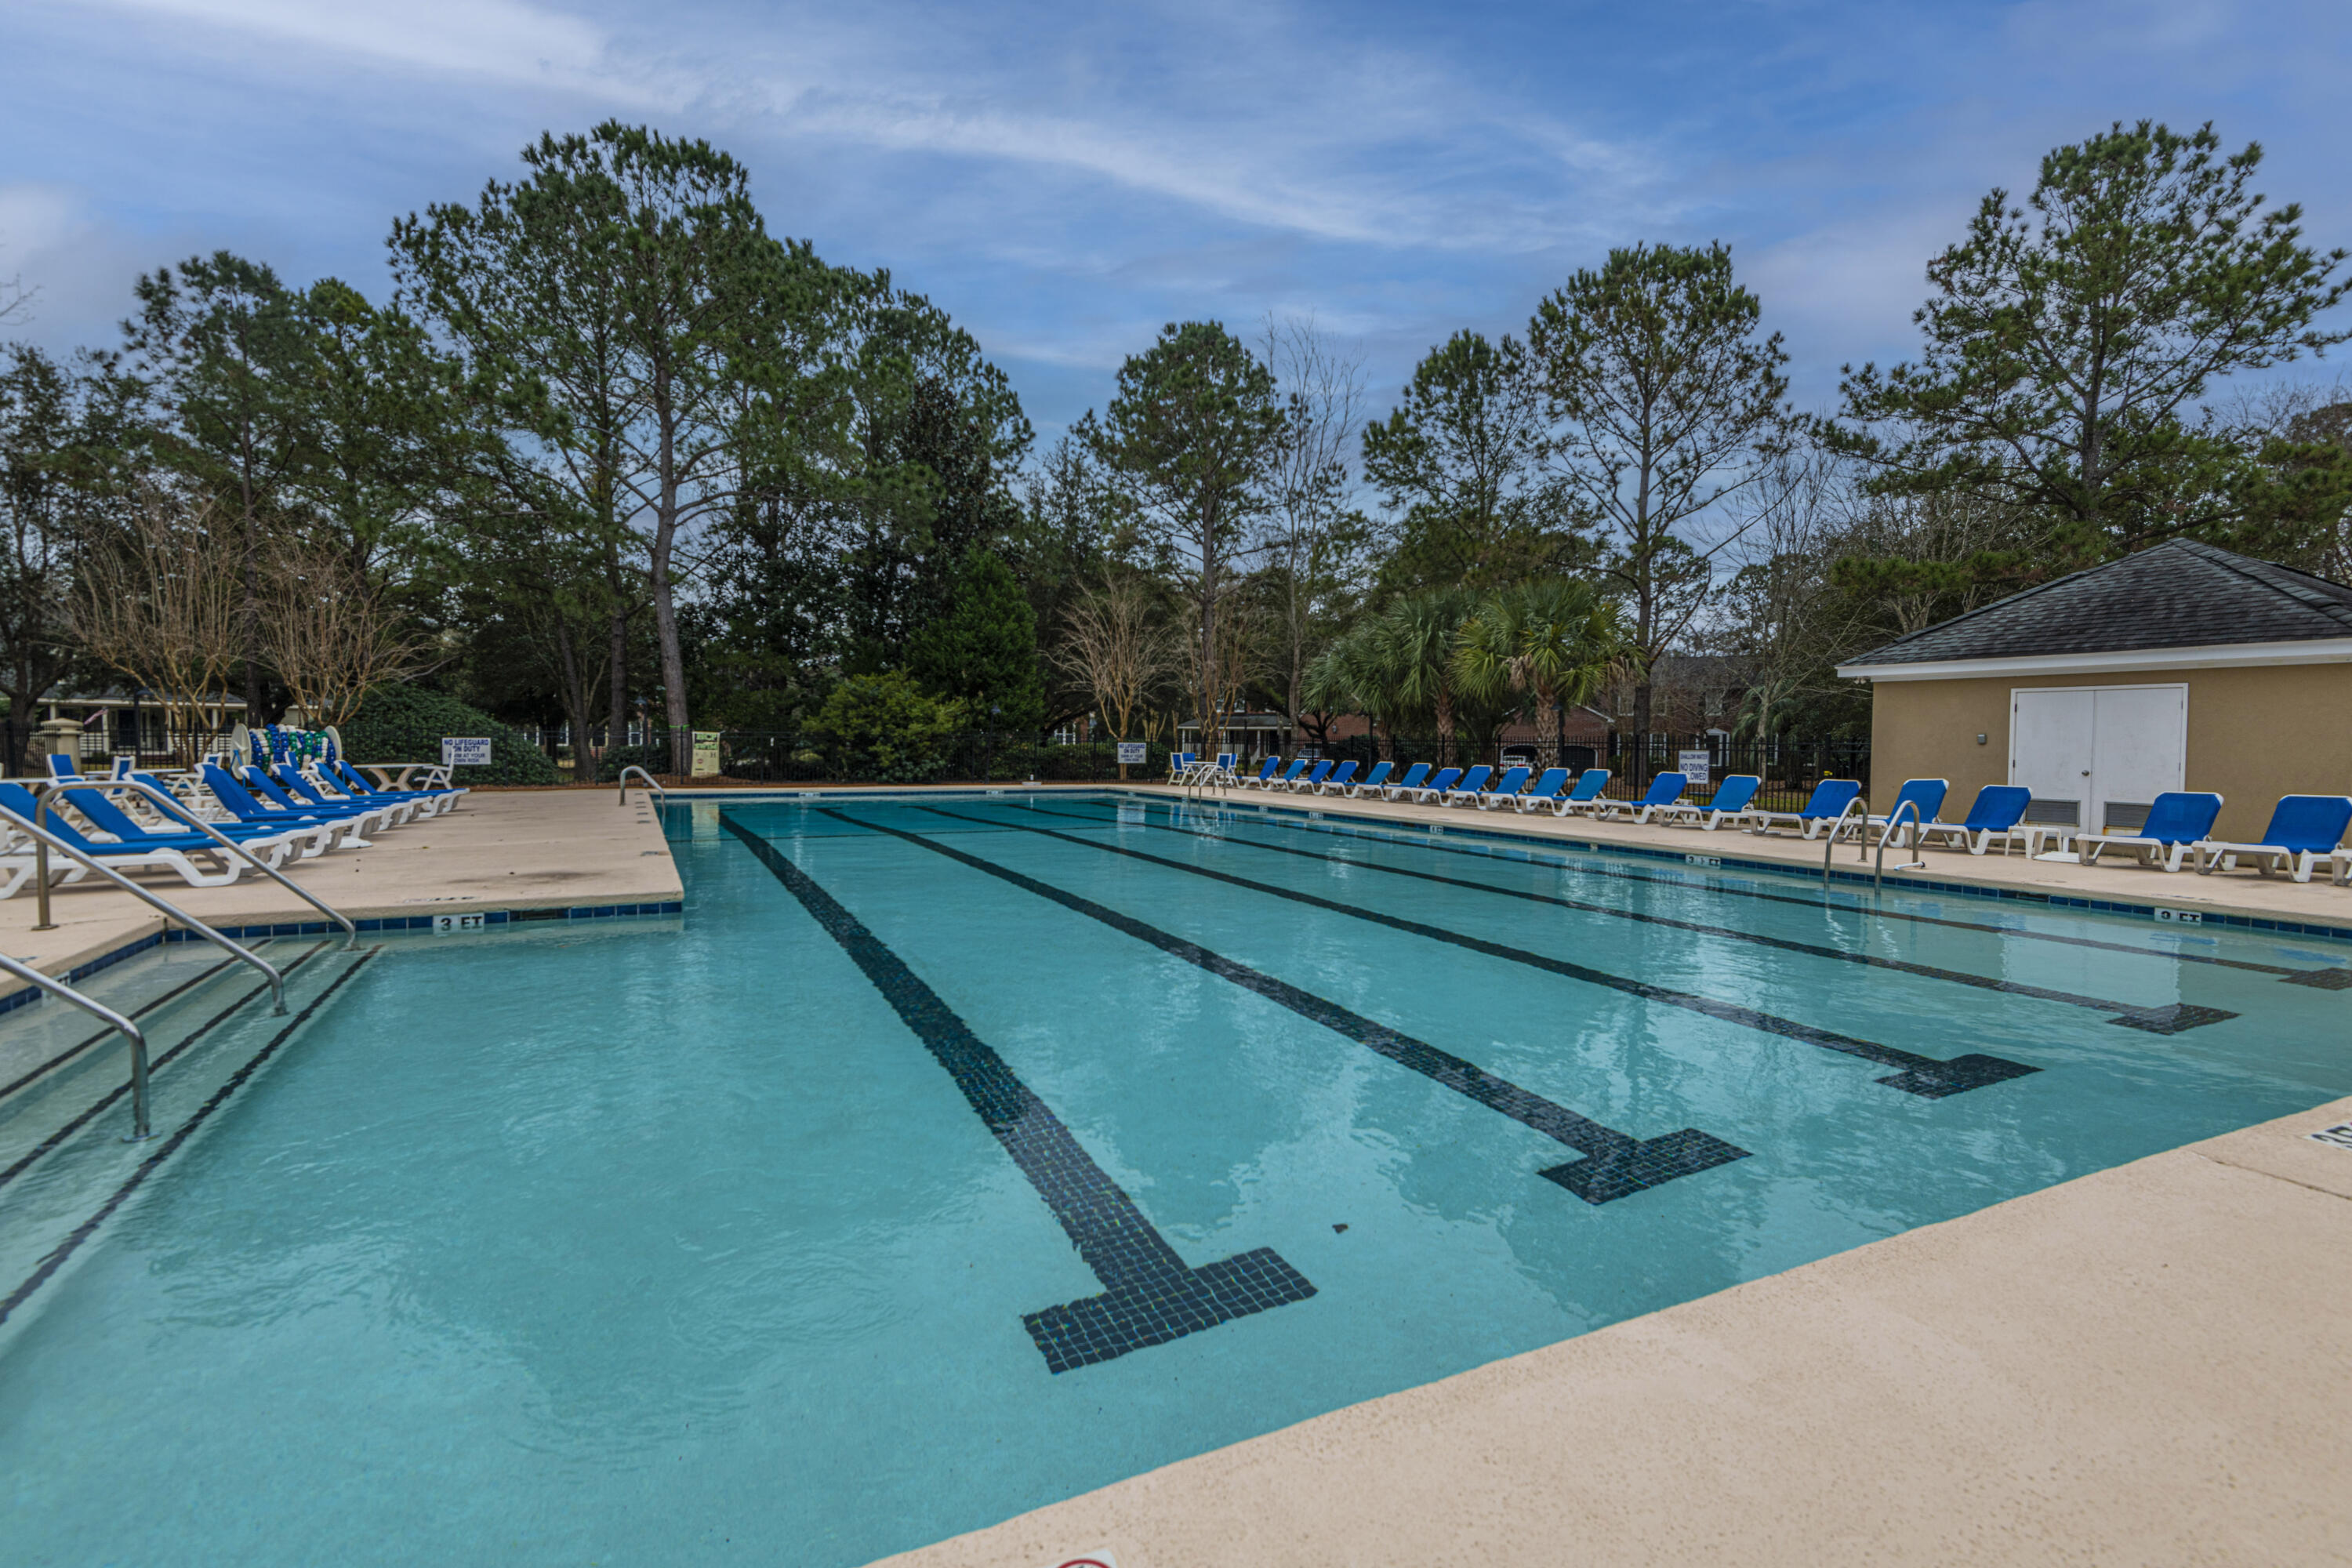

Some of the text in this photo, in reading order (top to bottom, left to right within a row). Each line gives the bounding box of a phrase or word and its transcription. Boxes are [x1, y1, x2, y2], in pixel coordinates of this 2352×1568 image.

[1680, 763, 1708, 772] NO DIVING
[441, 916, 482, 931] 3 FT
